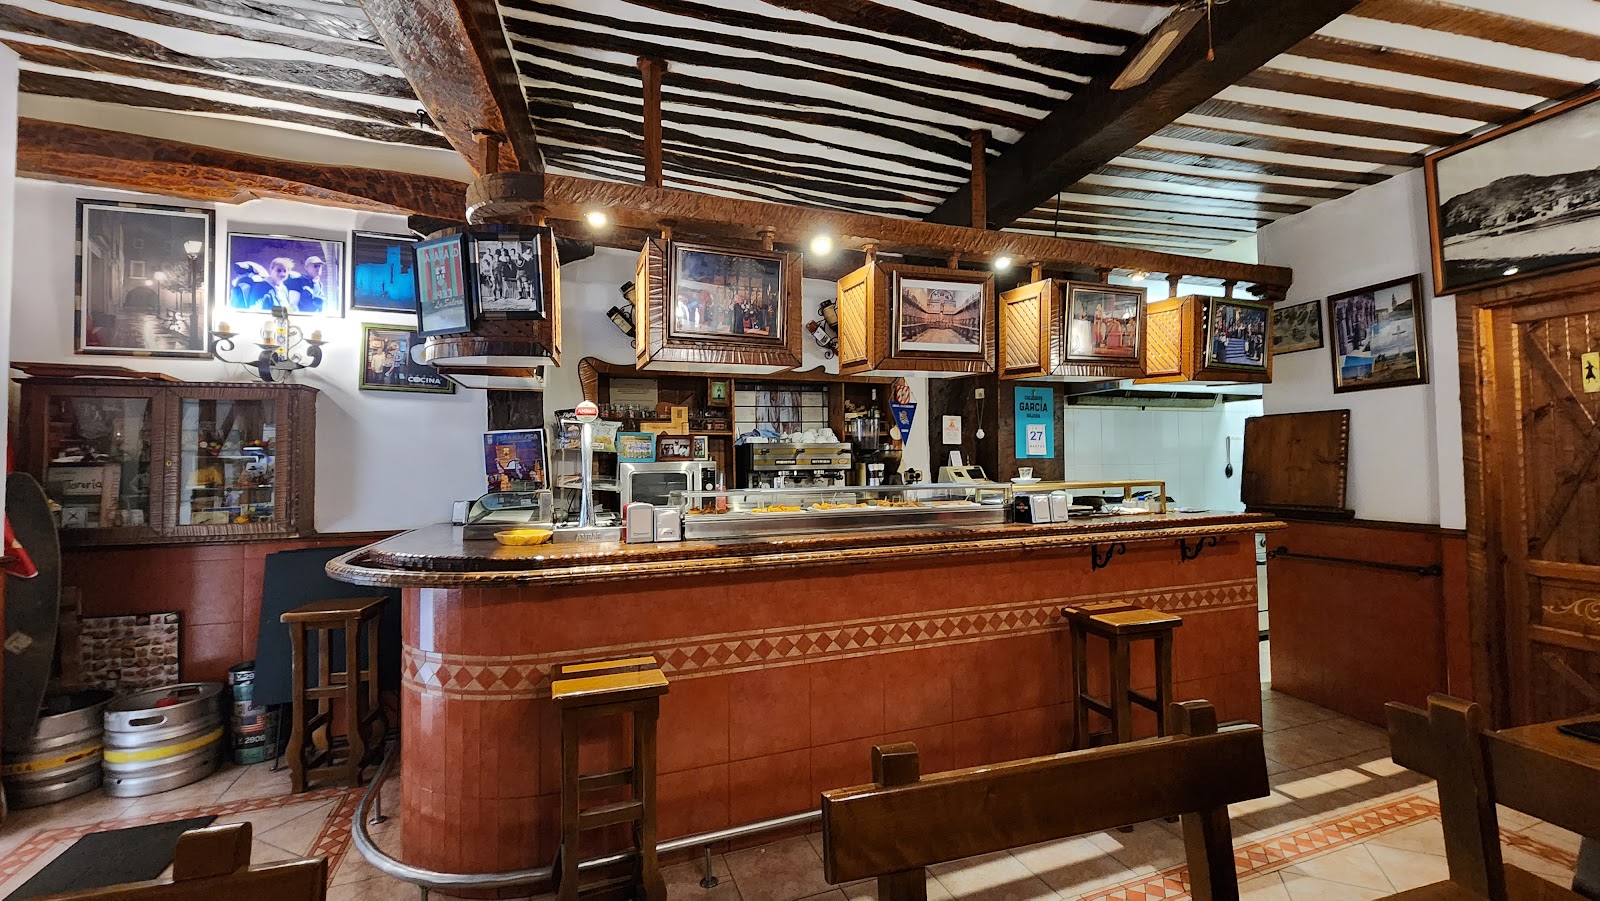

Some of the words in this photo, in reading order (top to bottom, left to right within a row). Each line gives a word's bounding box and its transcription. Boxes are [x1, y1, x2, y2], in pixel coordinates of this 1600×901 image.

[407, 376, 441, 384] COCINA
[1019, 400, 1048, 412] GARCÍA
[1029, 431, 1043, 441] 27
